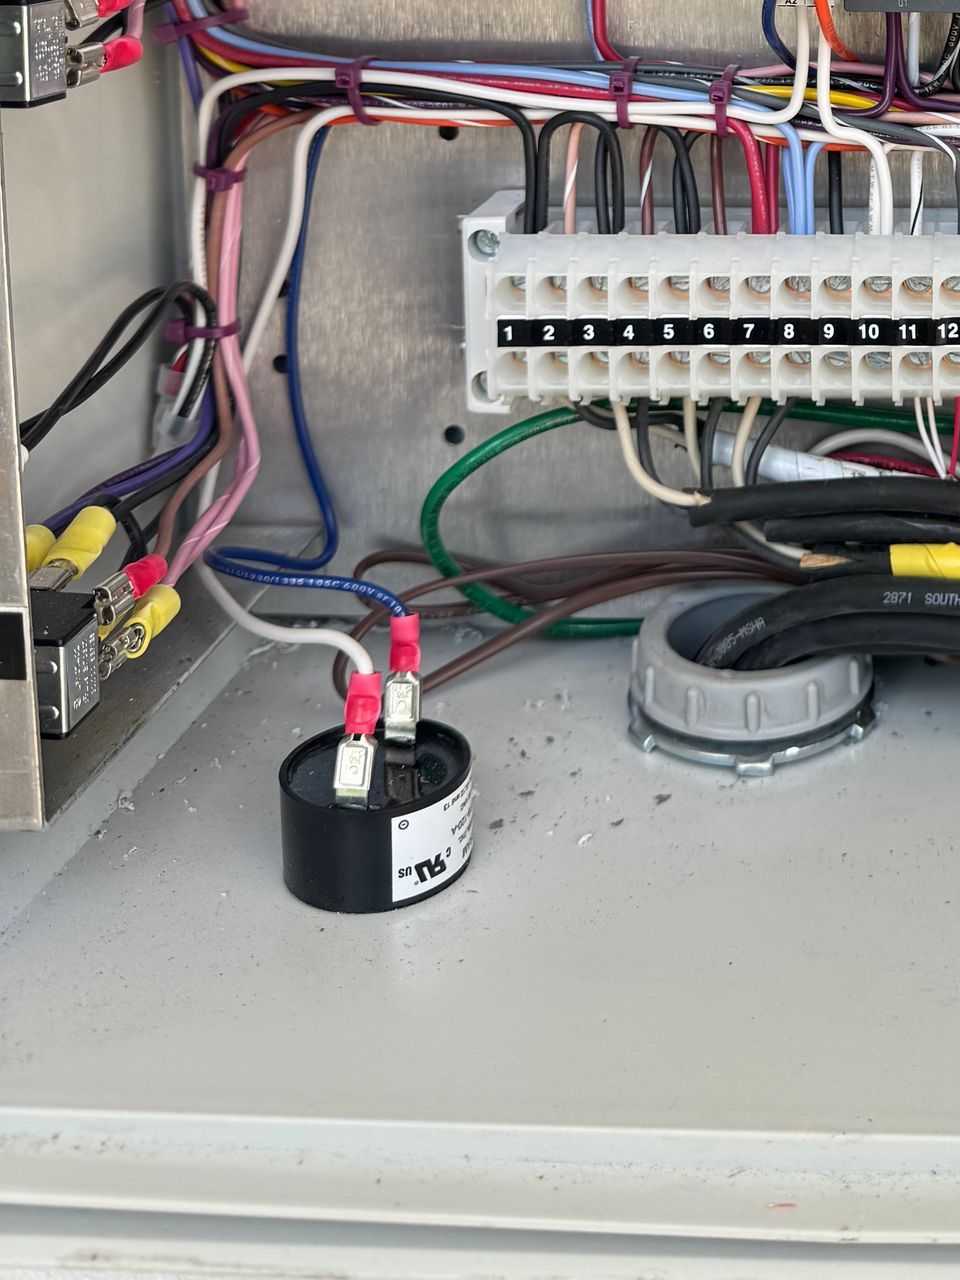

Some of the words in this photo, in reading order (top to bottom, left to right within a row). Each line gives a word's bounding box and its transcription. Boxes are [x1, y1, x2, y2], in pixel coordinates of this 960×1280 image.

[503, 325, 513, 341] 1
[543, 325, 555, 341] 2
[582, 325, 595, 340] 3
[623, 325, 635, 340] 4
[663, 324, 675, 339] 5
[703, 324, 715, 339] 6
[743, 324, 755, 339] 7
[783, 324, 795, 339] 8
[823, 324, 835, 339] 9
[858, 324, 879, 339] 10
[899, 324, 917, 340] 11
[937, 323, 959, 339] 12
[883, 592, 912, 604] 2871
